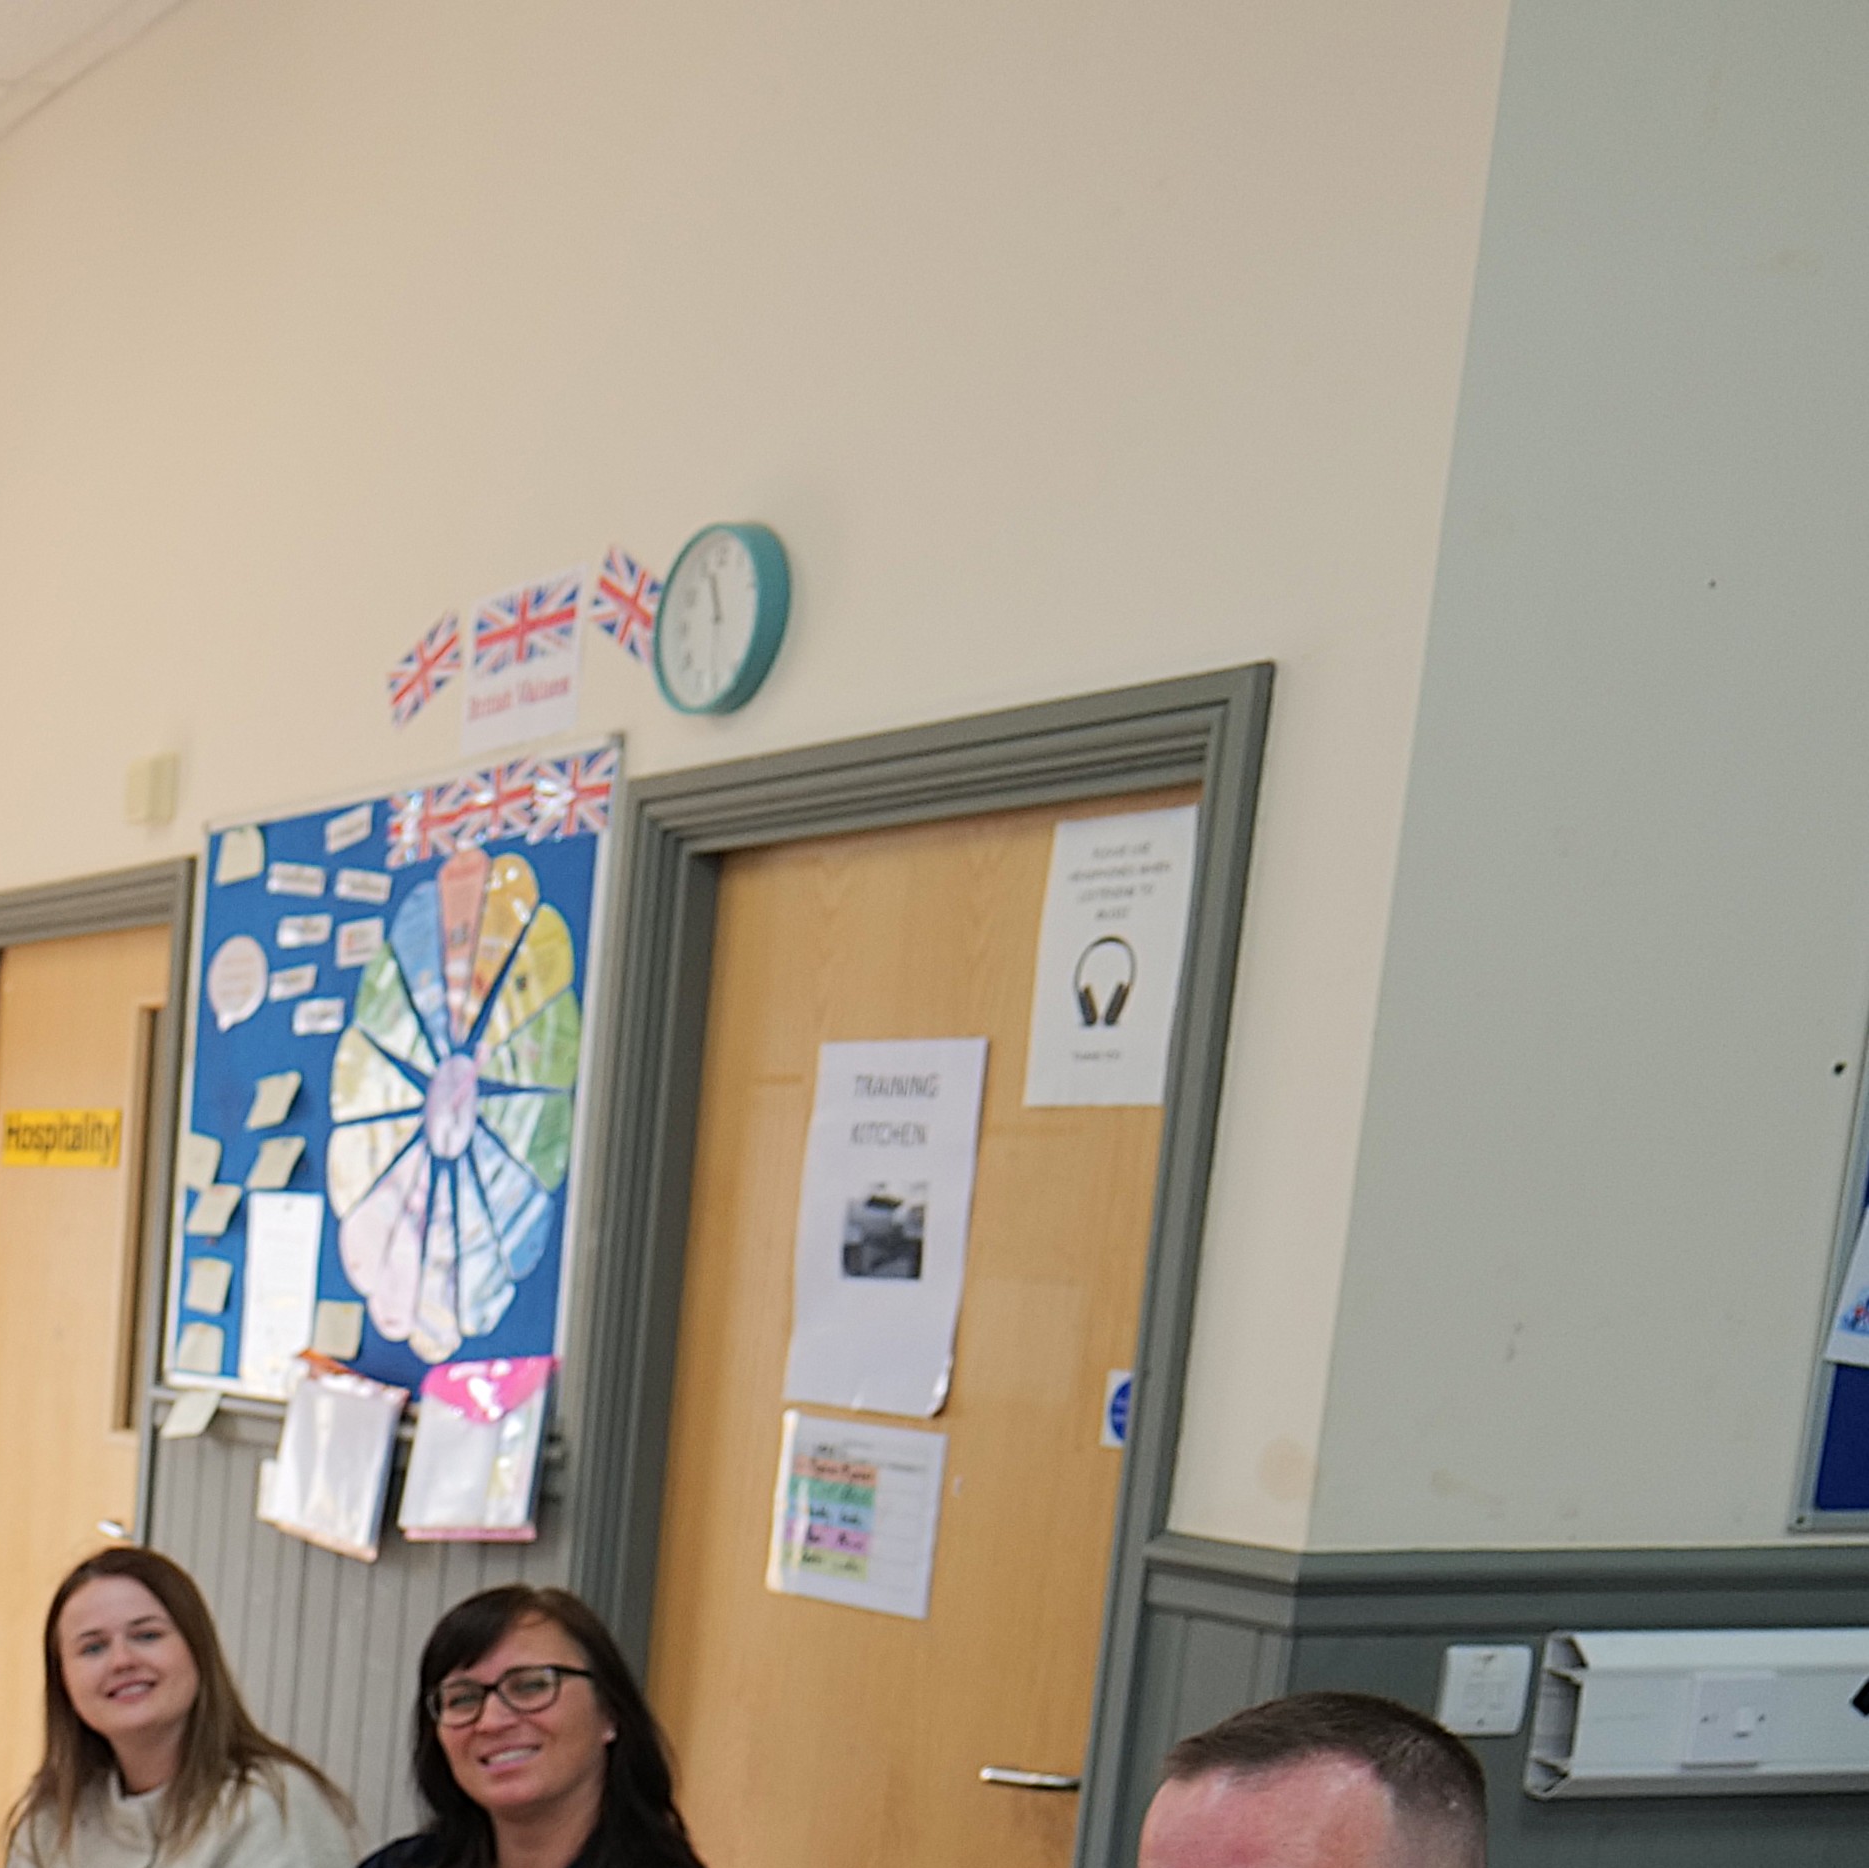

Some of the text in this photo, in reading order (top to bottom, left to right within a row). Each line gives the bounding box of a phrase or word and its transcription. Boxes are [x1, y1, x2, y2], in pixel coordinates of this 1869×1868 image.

[855, 1073, 941, 1097] TRAINING
[8, 1112, 117, 1165] Hospitality
[850, 1122, 927, 1146] KITCHEN
